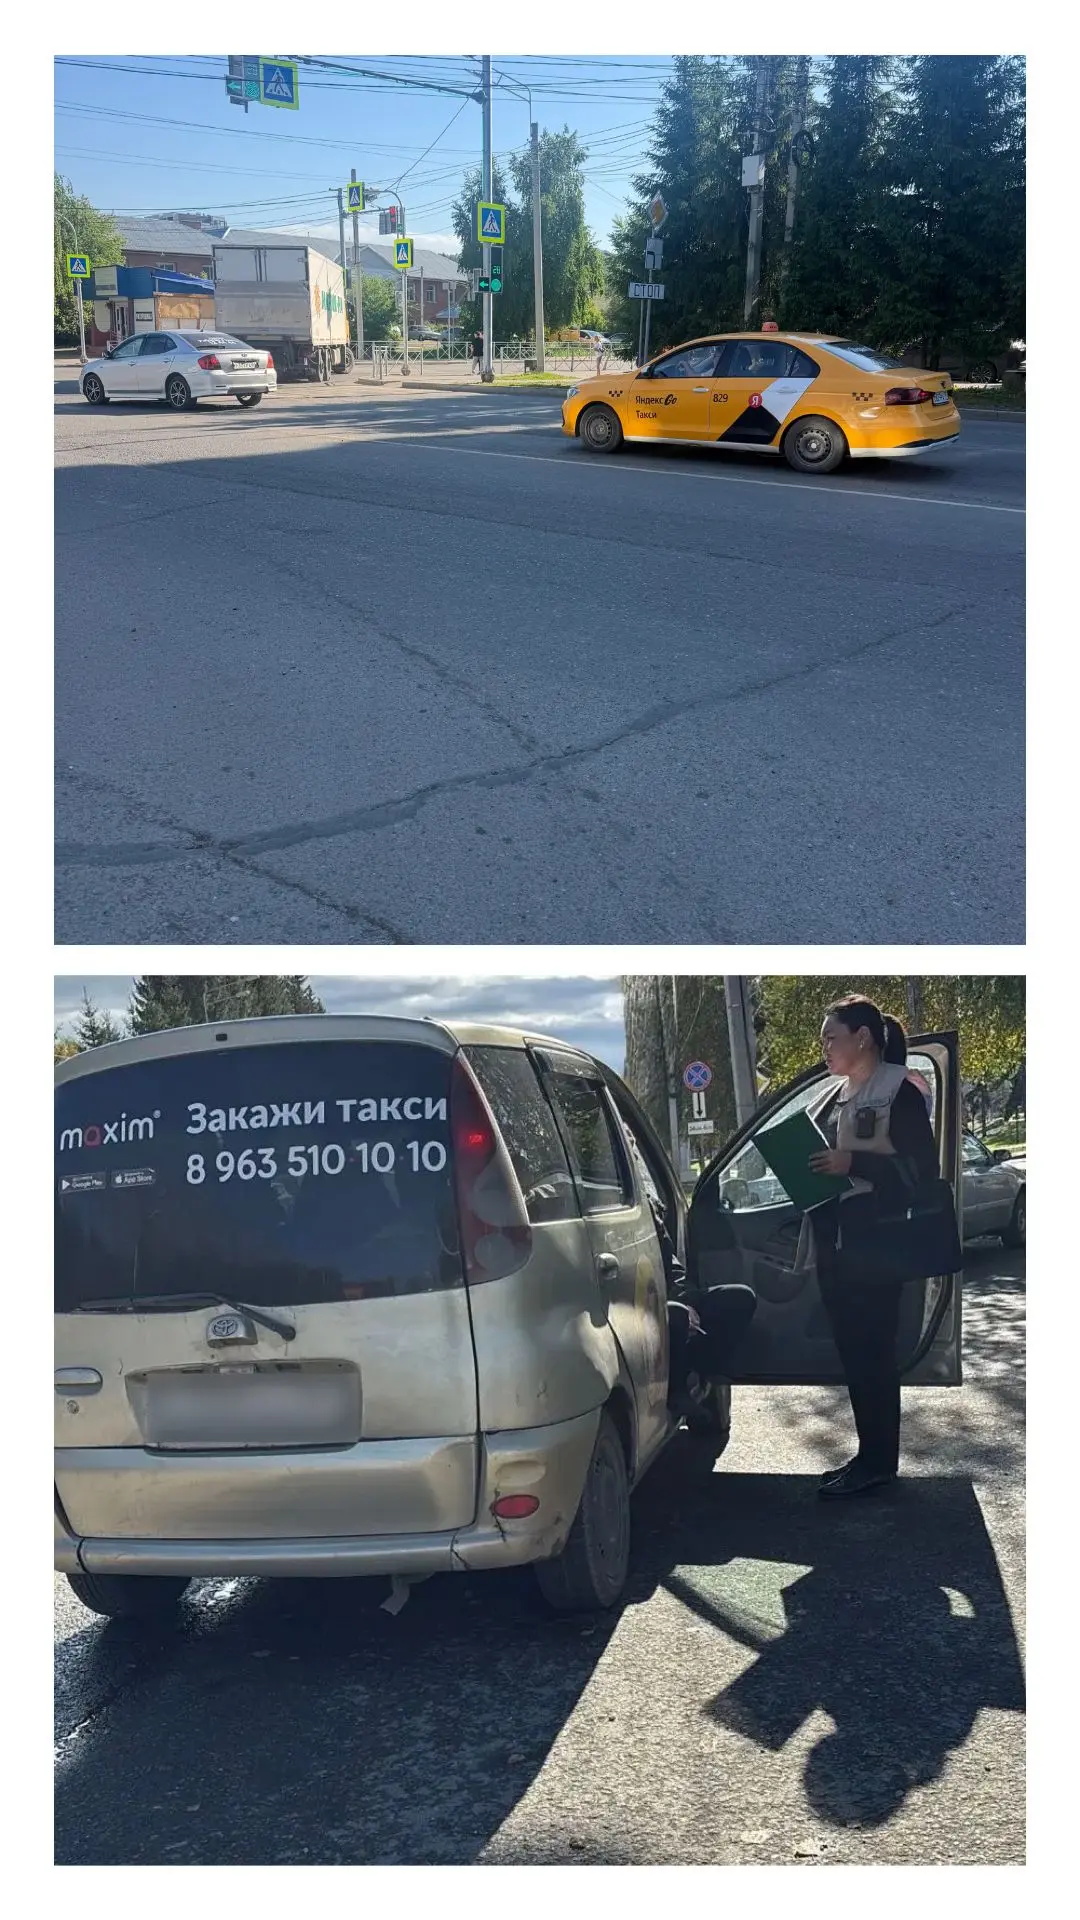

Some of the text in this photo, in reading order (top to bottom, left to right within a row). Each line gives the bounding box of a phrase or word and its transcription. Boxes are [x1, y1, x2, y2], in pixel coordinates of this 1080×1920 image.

[634, 283, 660, 298] СТОП
[635, 394, 678, 406] Яндекс Go
[713, 393, 729, 403] 829
[751, 396, 760, 406] Я
[636, 410, 657, 419] Такси
[186, 1097, 447, 1134] Закажи такси
[186, 1140, 447, 1184] 8 963 510 10 10
[71, 1180, 92, 1189] Google
